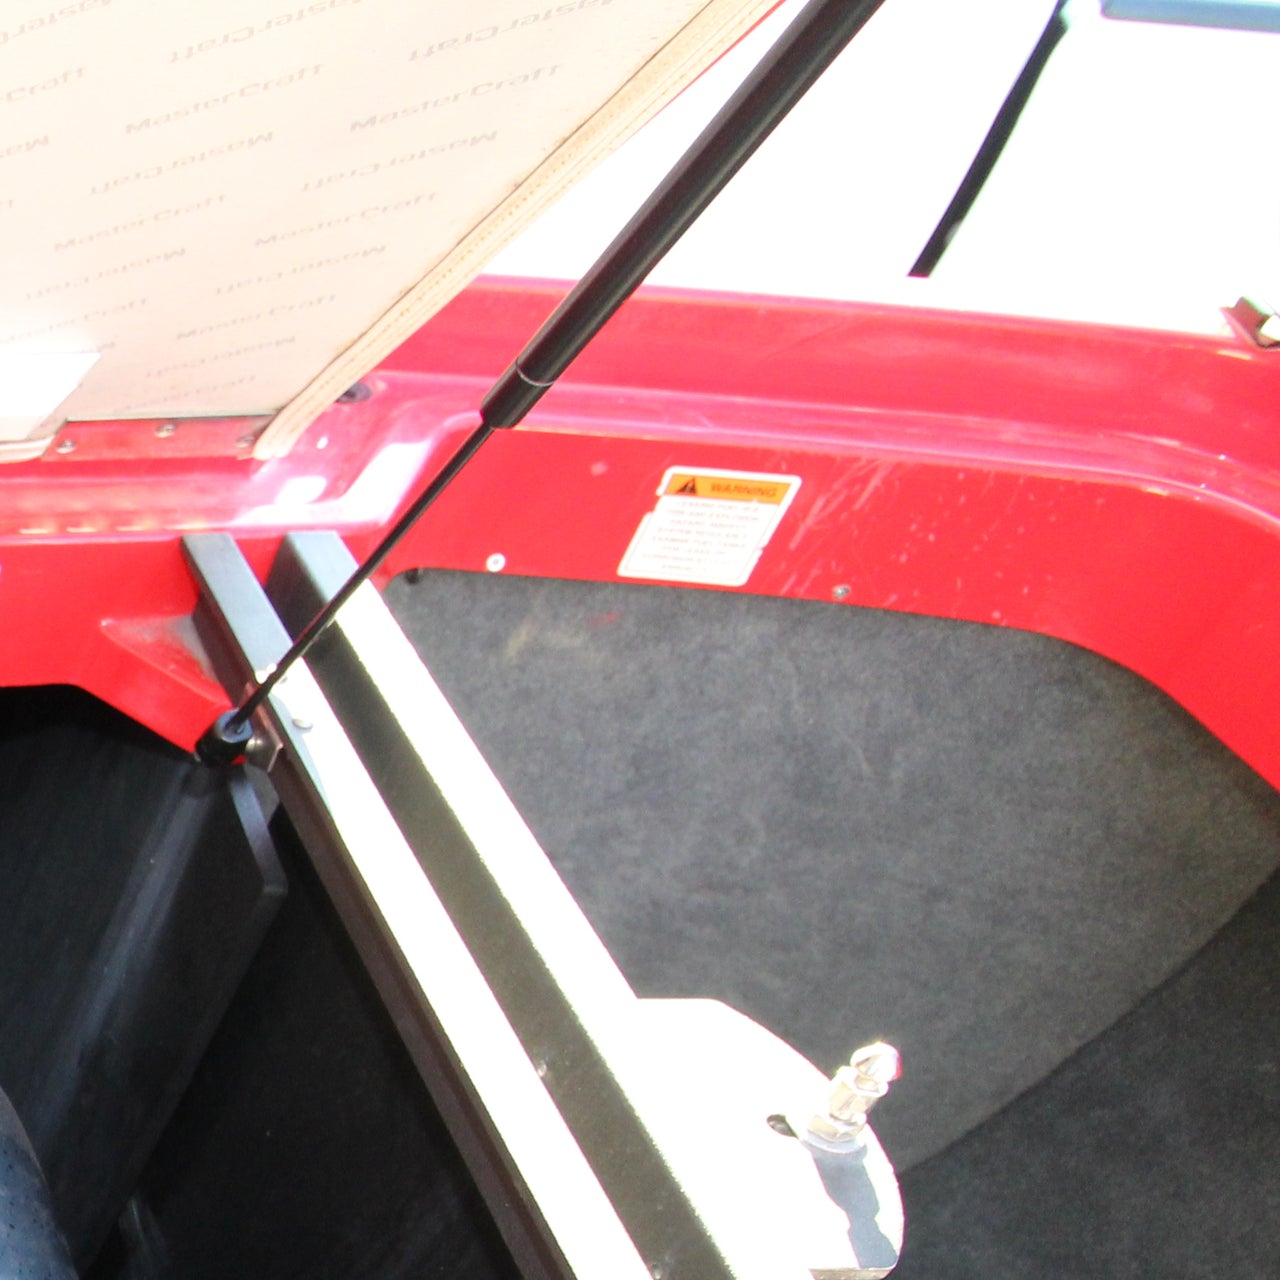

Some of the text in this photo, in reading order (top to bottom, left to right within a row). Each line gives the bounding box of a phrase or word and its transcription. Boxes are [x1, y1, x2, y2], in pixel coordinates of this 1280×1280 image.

[125, 63, 324, 135] MasterCraft
[349, 63, 564, 133] MasterCraft
[90, 130, 275, 195] MasterCraft
[301, 130, 498, 193] MasterCraft
[53, 193, 226, 252] MasterCraft
[254, 191, 439, 248] MasterCraft
[710, 482, 778, 498] WARNING
